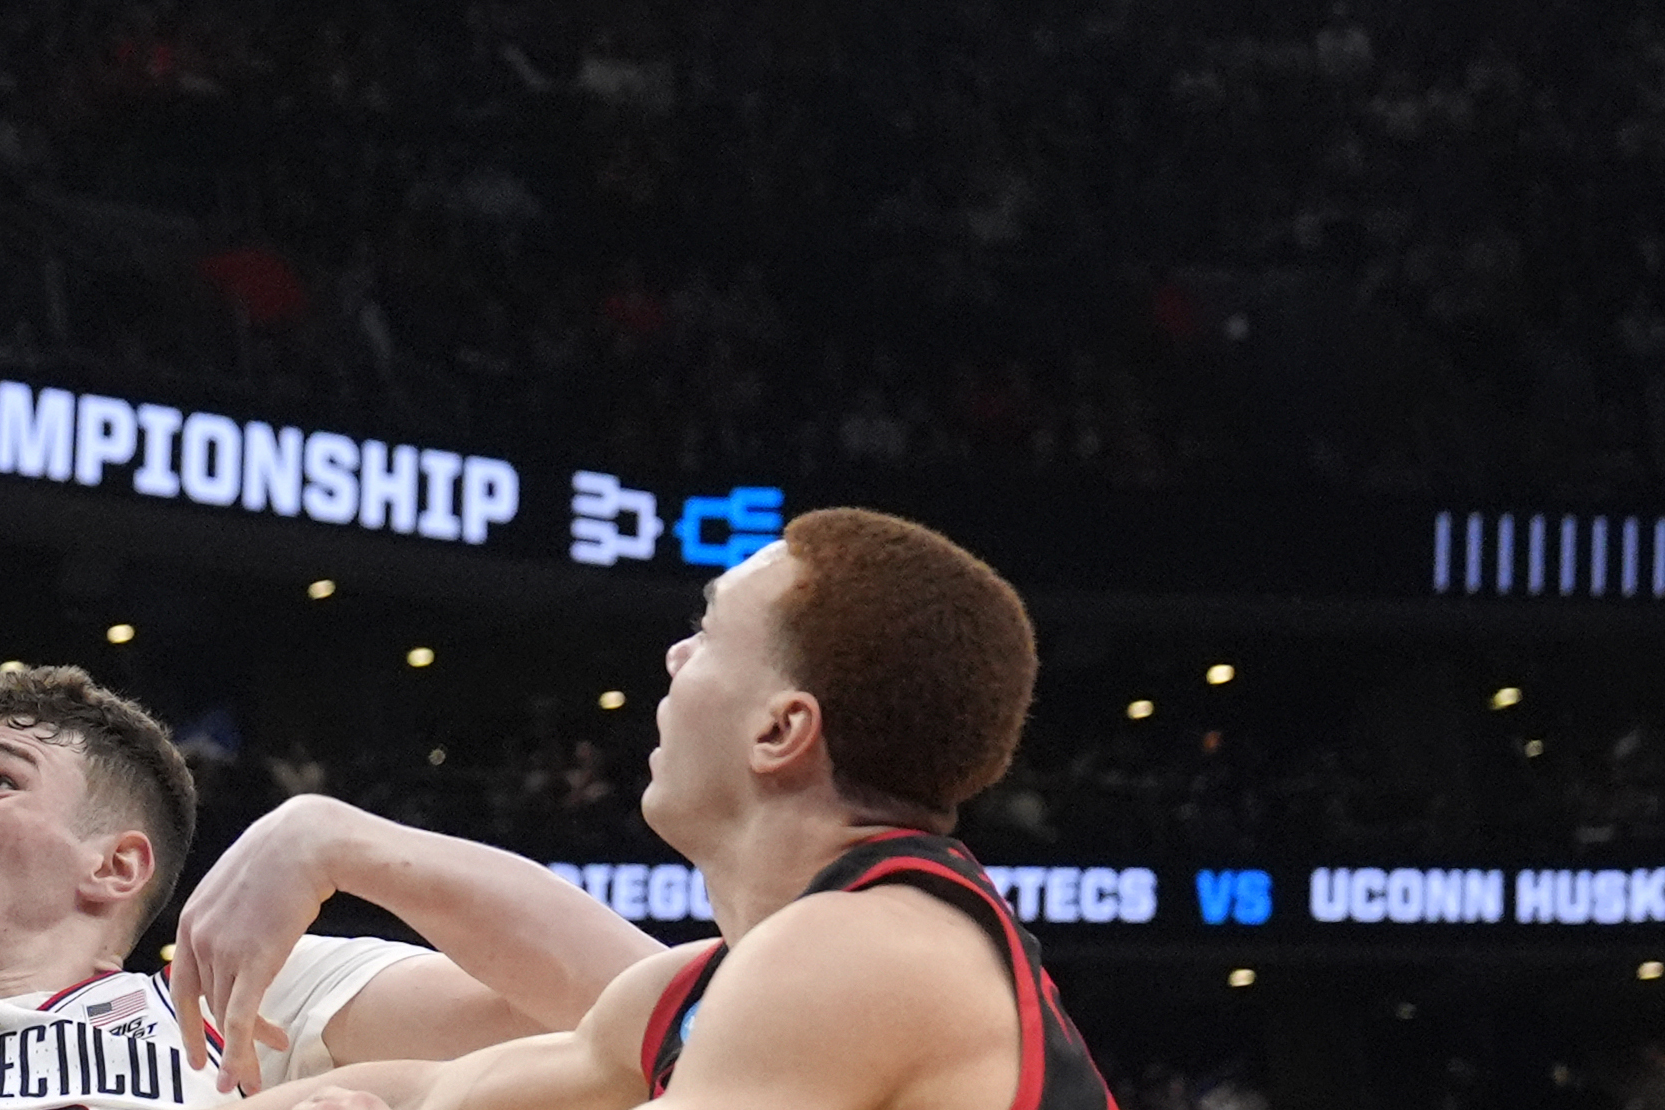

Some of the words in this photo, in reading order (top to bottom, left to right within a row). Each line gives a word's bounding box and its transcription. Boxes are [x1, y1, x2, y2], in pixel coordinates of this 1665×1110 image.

[1195, 868, 1273, 925] VS
[1309, 866, 1505, 924] UCONN
[1515, 866, 1665, 925] HUSK
